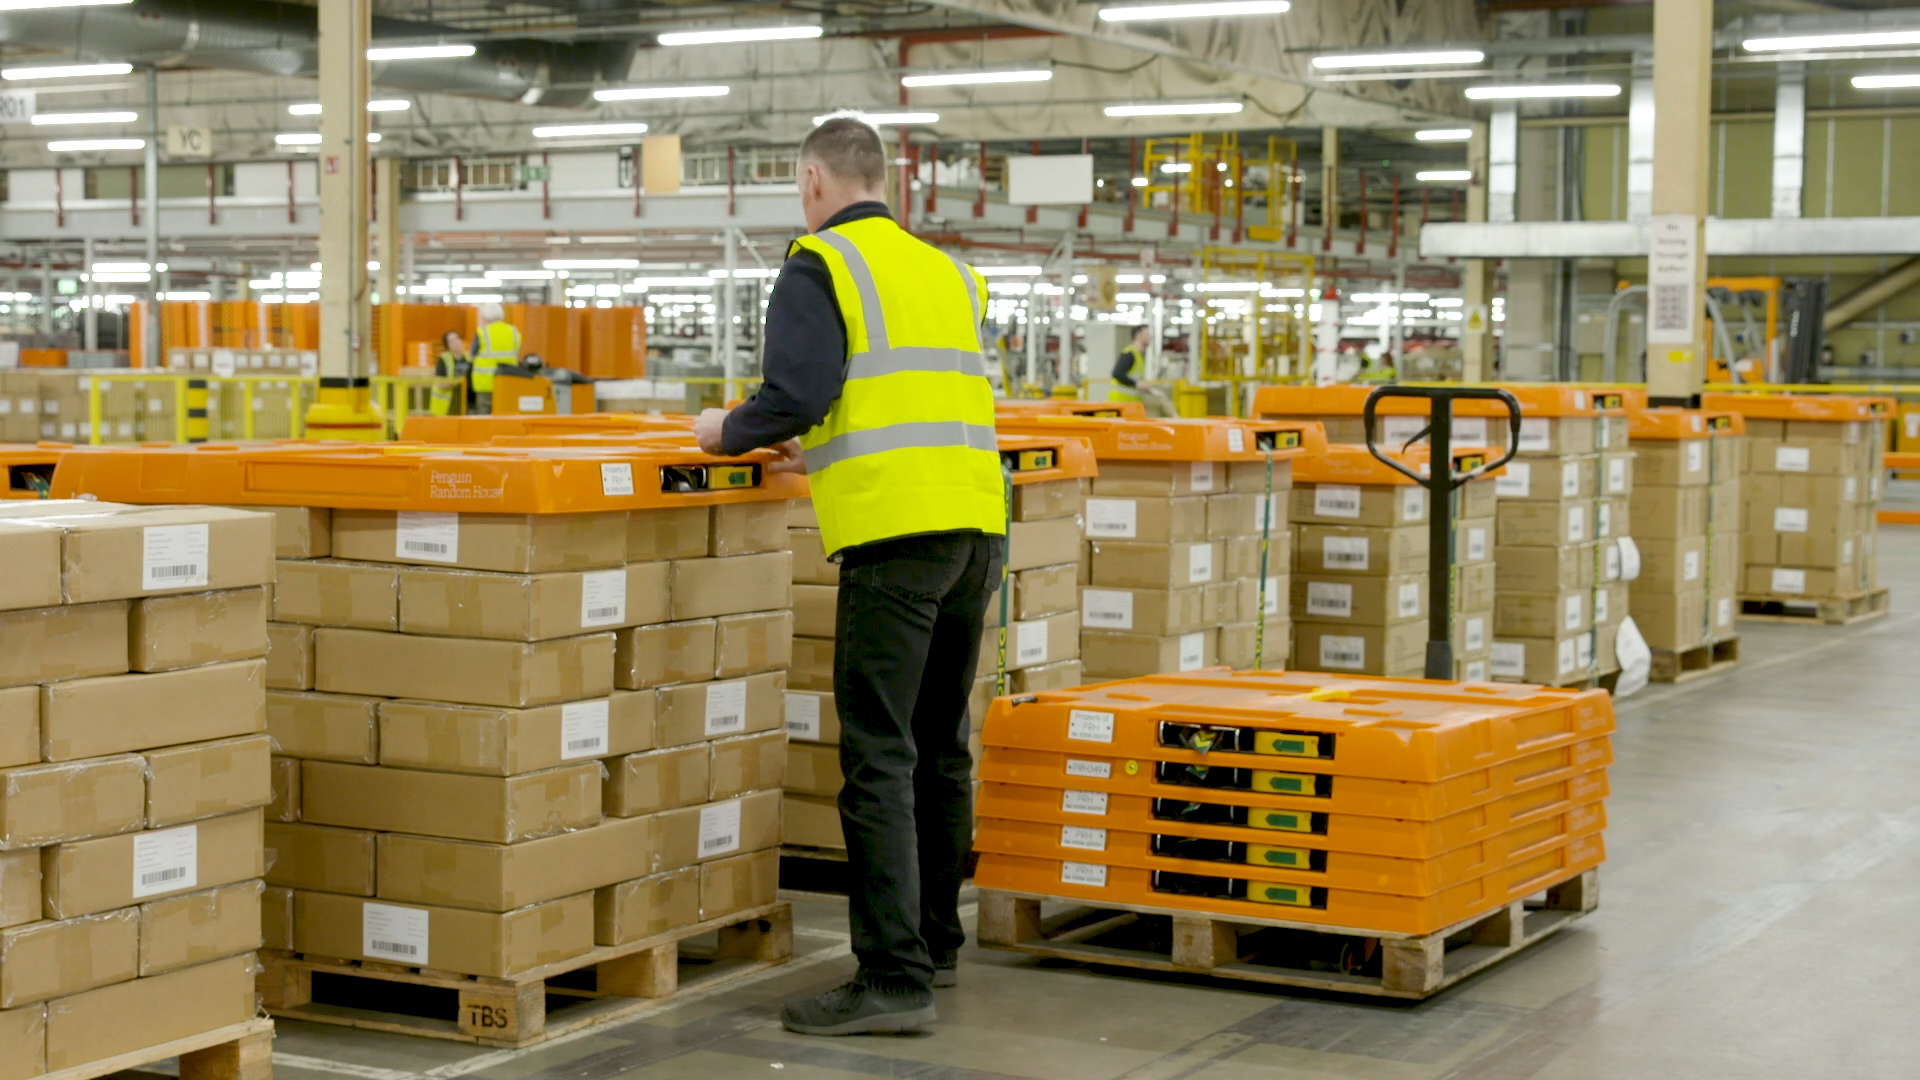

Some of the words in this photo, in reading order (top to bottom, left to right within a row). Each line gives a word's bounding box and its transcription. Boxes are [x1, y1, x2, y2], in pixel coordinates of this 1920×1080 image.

[179, 129, 202, 151] YC
[430, 469, 472, 489] Penguin
[430, 484, 472, 499] Random
[466, 1004, 508, 1029] TBS
